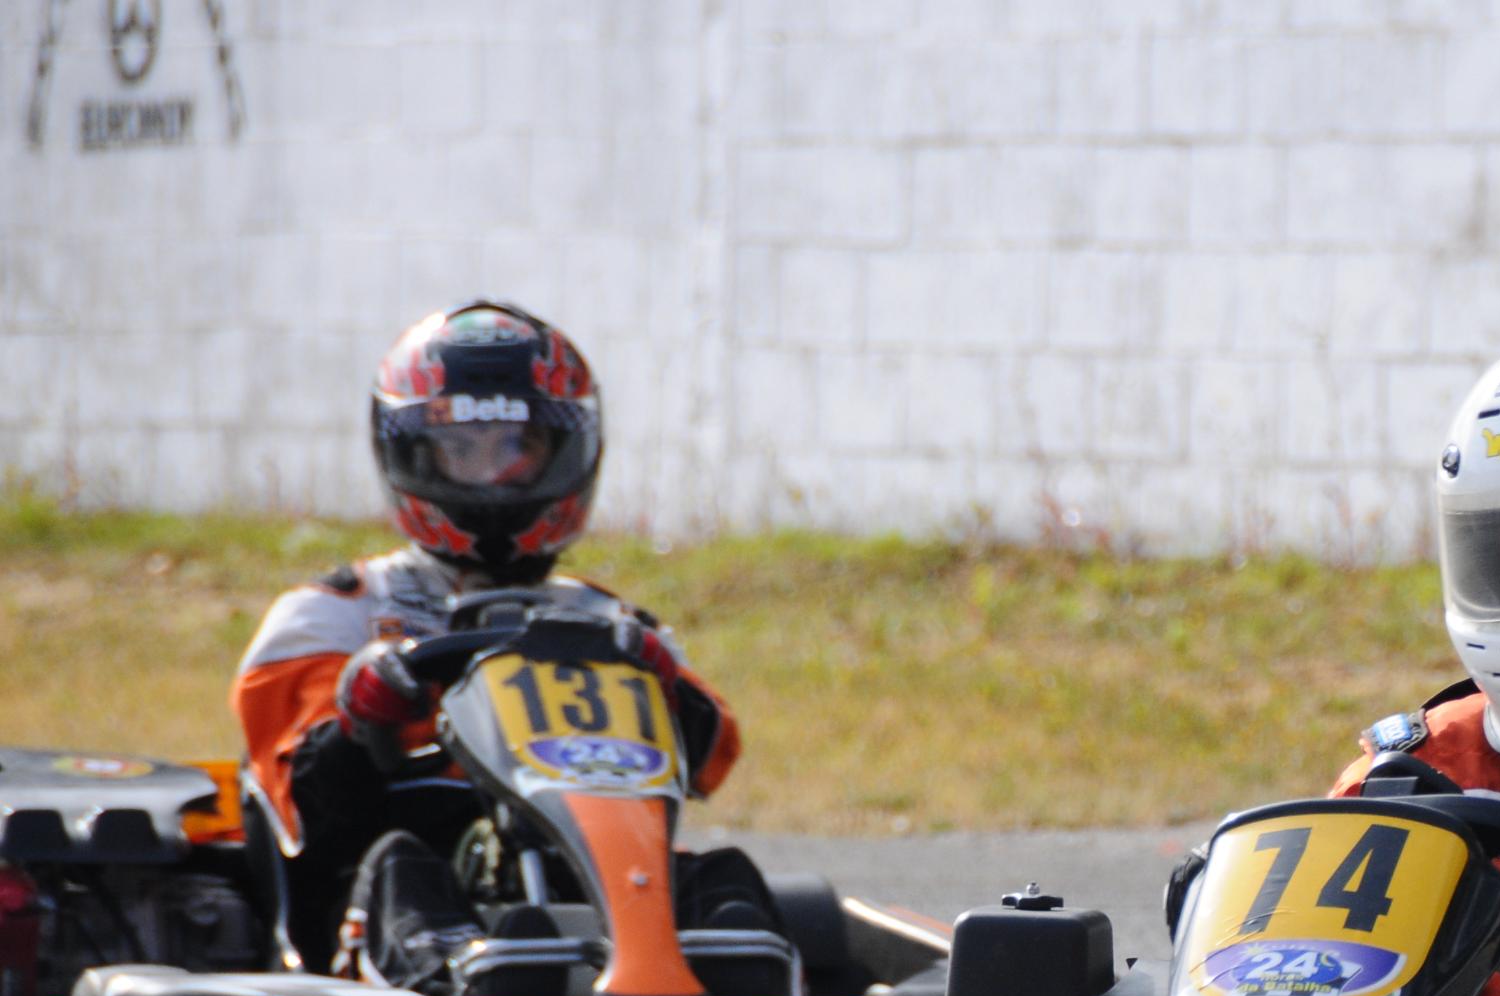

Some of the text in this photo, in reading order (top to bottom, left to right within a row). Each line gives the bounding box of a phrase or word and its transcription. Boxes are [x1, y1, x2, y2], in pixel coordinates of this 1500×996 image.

[450, 394, 530, 422] Beta
[502, 665, 657, 743] 131
[1245, 951, 1321, 980] 24
